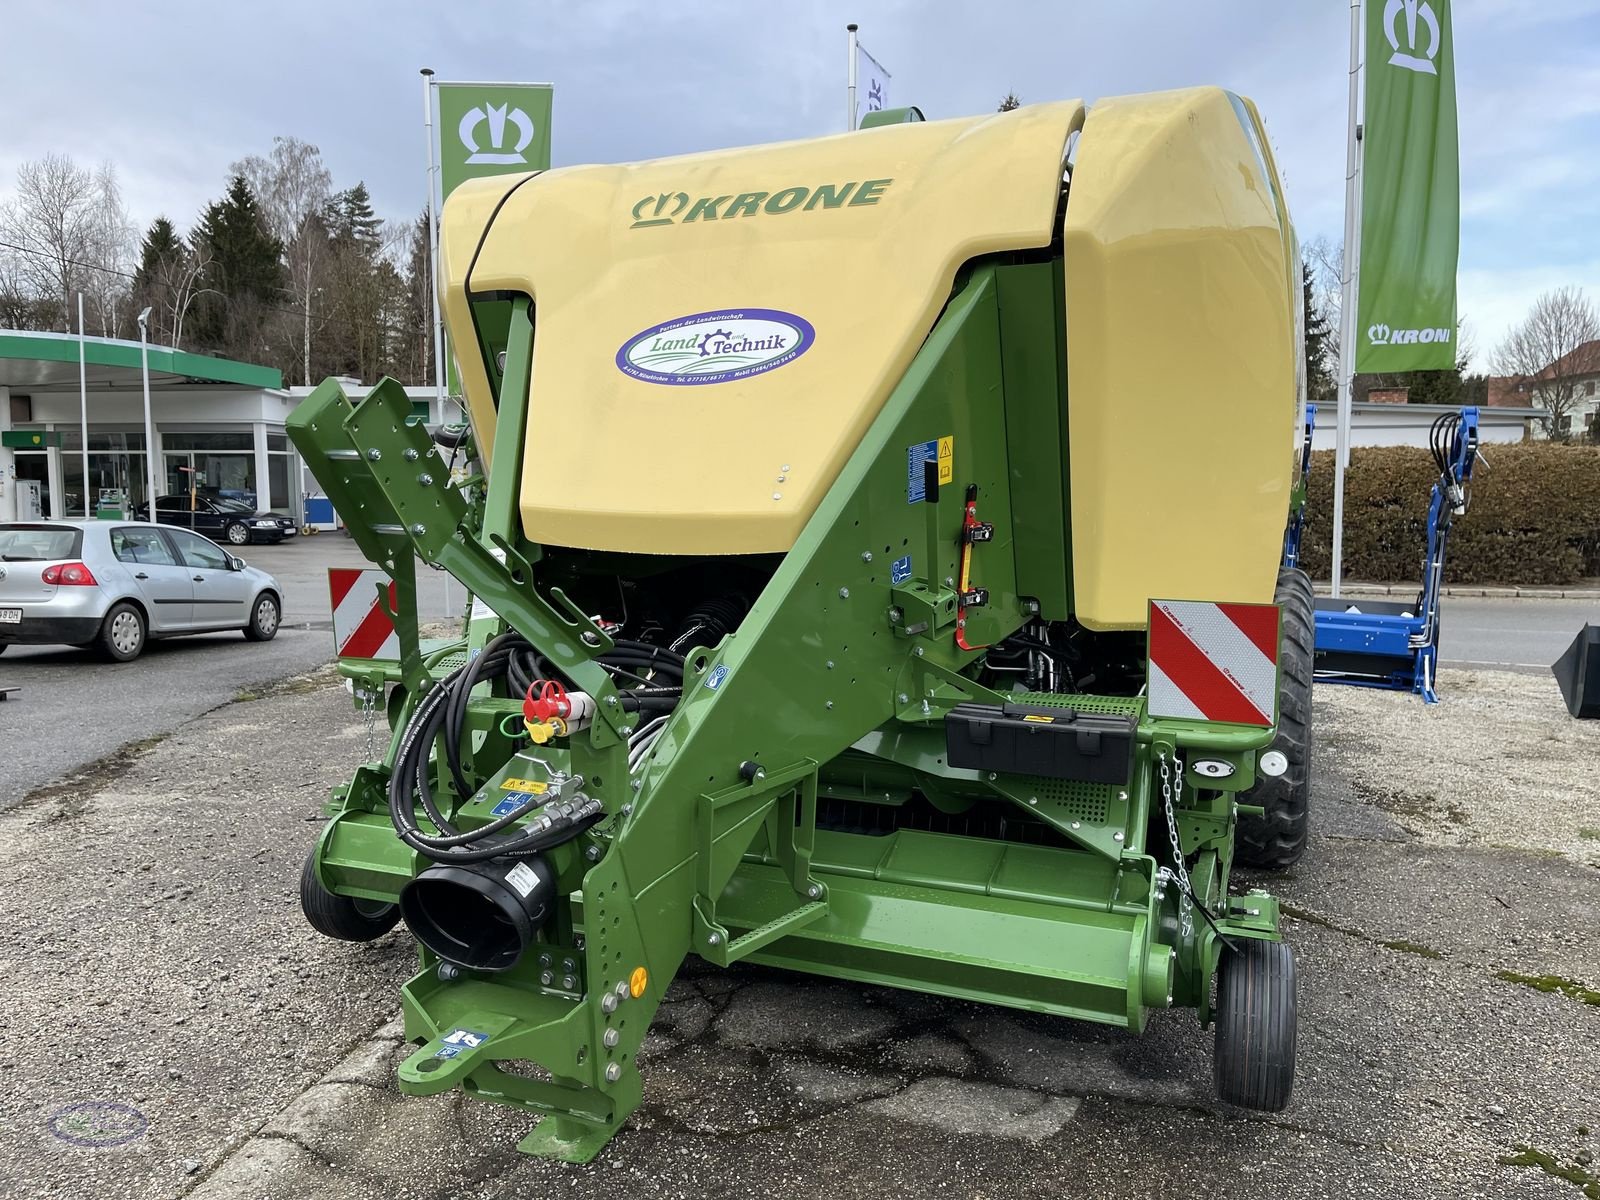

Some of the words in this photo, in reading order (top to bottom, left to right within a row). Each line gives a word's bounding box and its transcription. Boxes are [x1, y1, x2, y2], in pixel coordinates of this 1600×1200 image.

[682, 178, 895, 223] KRONE
[660, 323, 683, 332] Partner
[684, 319, 696, 327] der
[697, 313, 744, 324] Landwirtschaft
[650, 334, 700, 352] Land
[713, 334, 786, 354] Technik
[734, 369, 750, 377] Mobil
